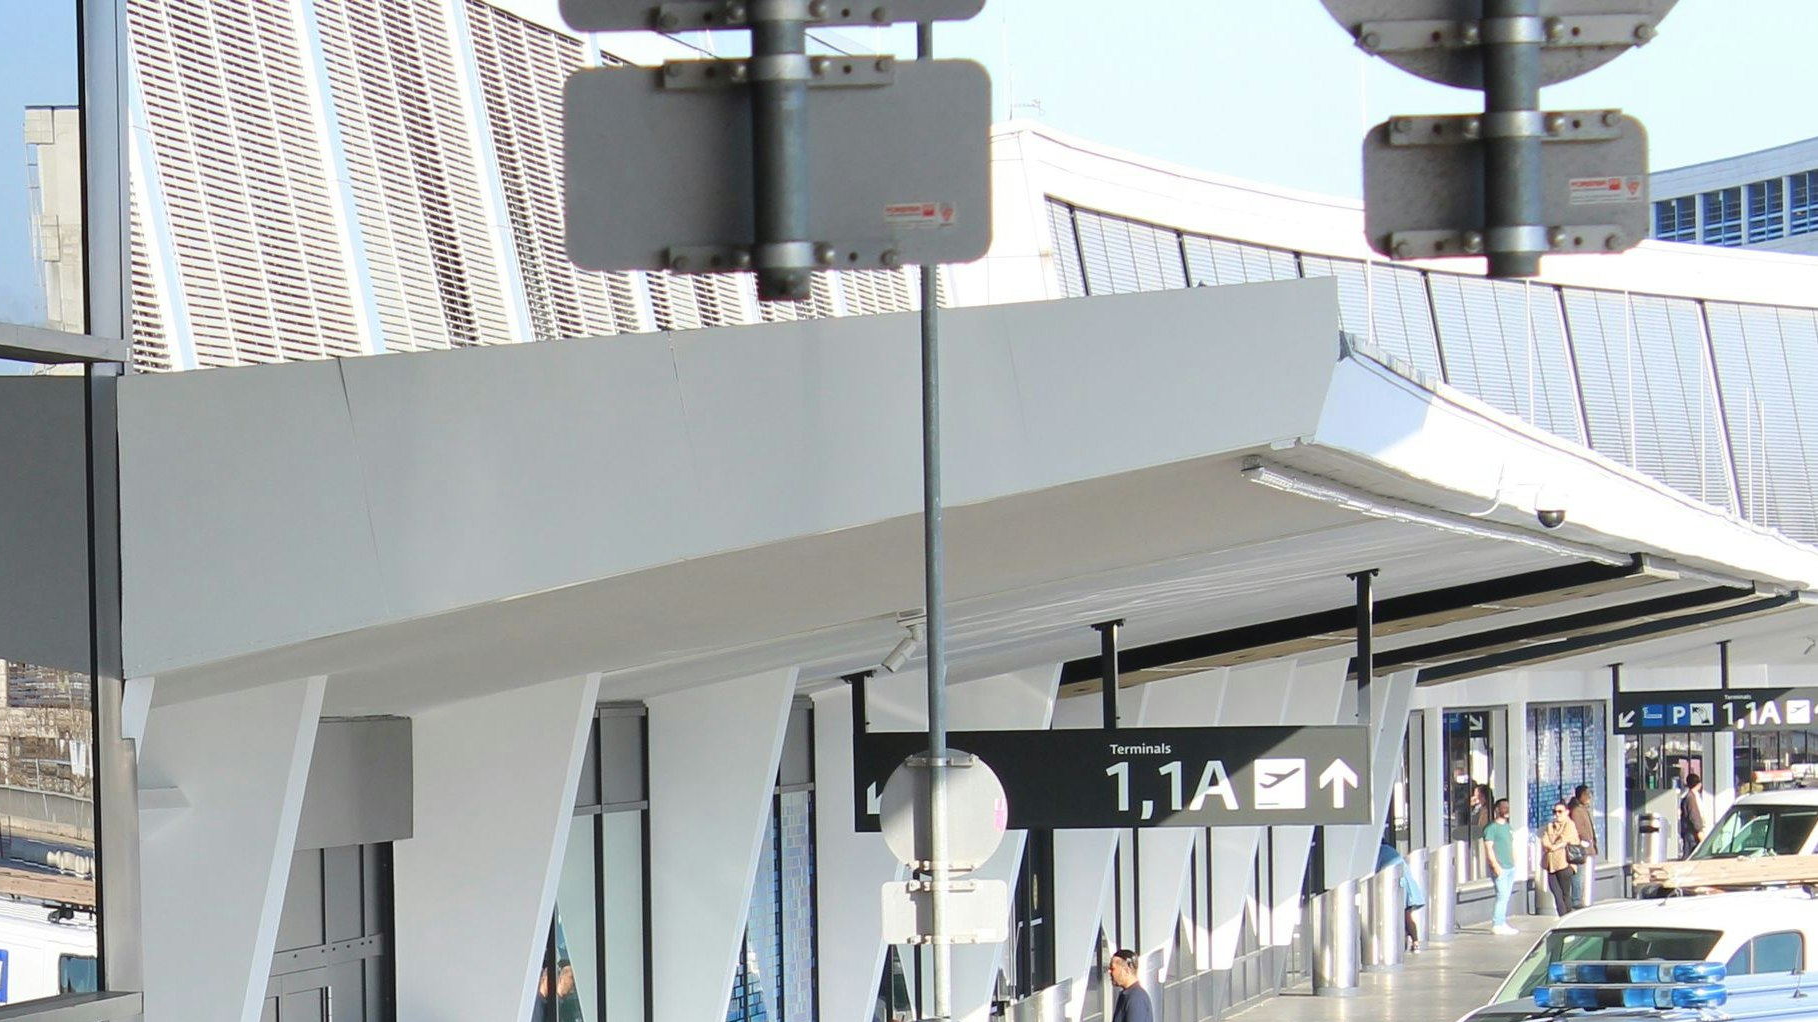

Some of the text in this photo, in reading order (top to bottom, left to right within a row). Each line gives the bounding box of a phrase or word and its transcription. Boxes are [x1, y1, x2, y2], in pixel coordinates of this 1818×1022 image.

[1722, 700, 1781, 729] 1,1A
[1109, 742, 1172, 755] Terminals
[1105, 760, 1239, 820] 1,1A
